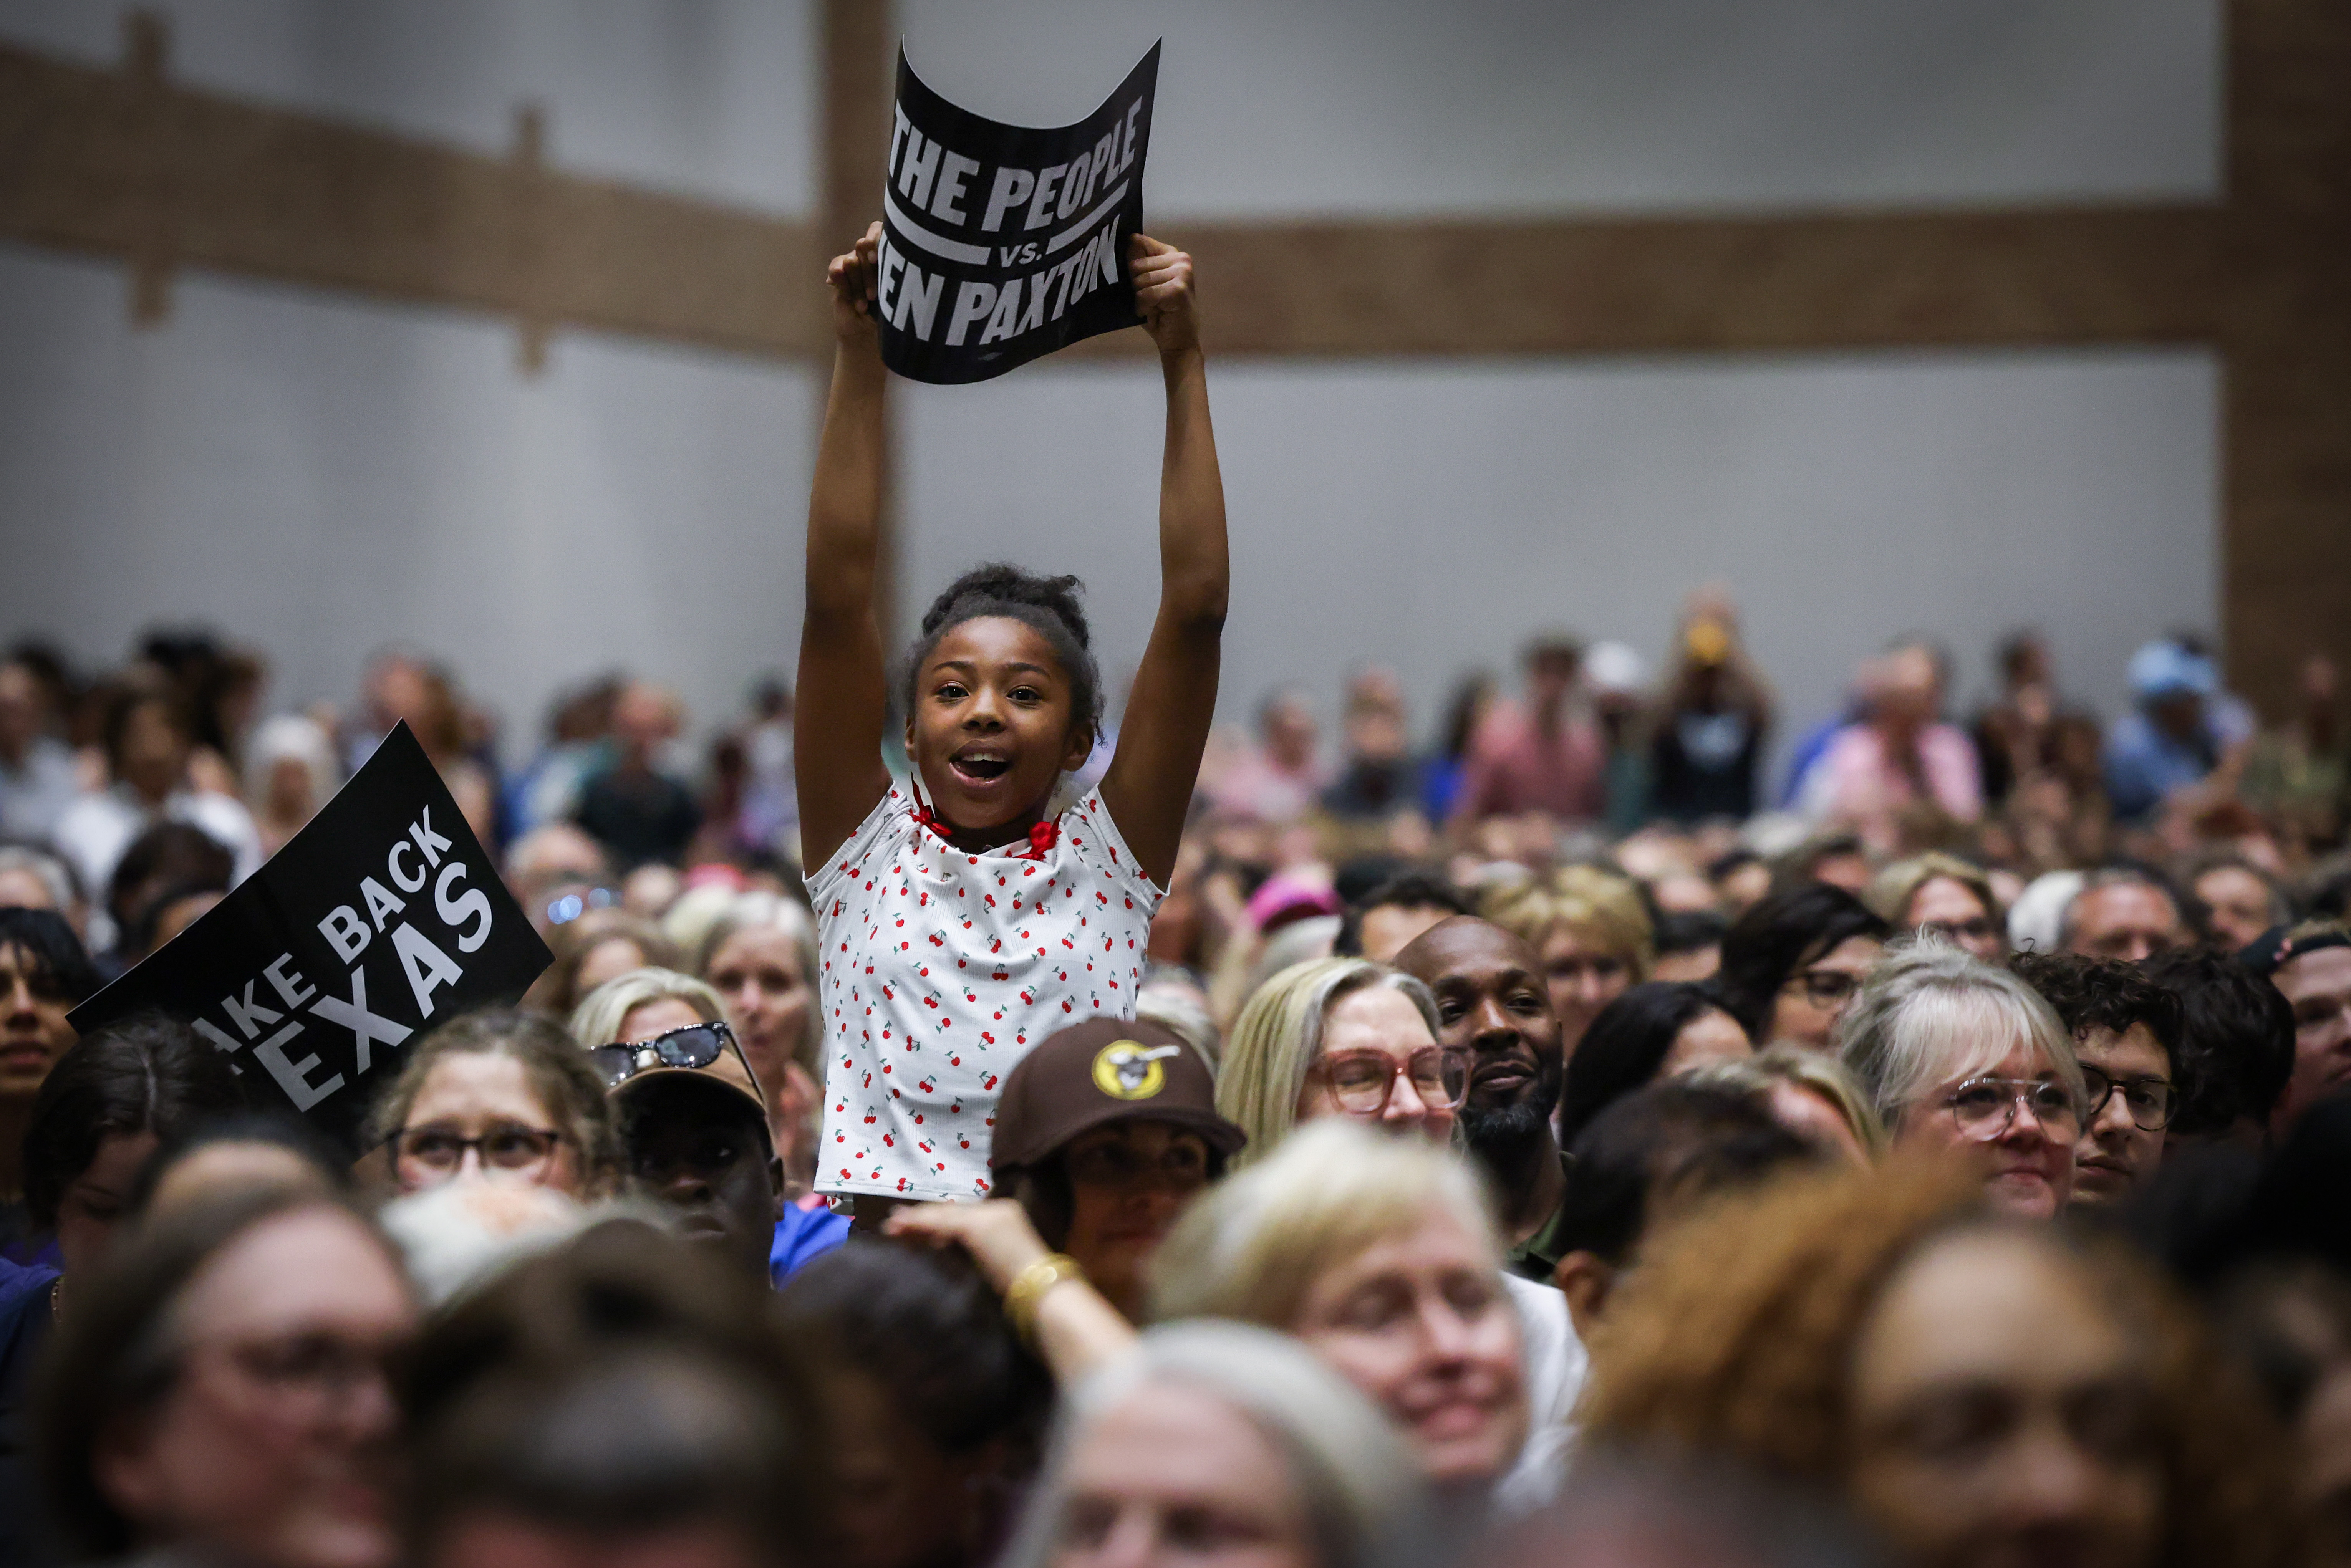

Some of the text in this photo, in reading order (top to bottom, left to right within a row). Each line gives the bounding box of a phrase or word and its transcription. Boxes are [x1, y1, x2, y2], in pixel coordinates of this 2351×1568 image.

[889, 96, 1142, 232] THE PEOPLE
[944, 213, 1120, 346] PAXTON
[999, 242, 1042, 268] VS.
[191, 804, 452, 1053] AKE BACK
[230, 862, 492, 1113] EXAS
